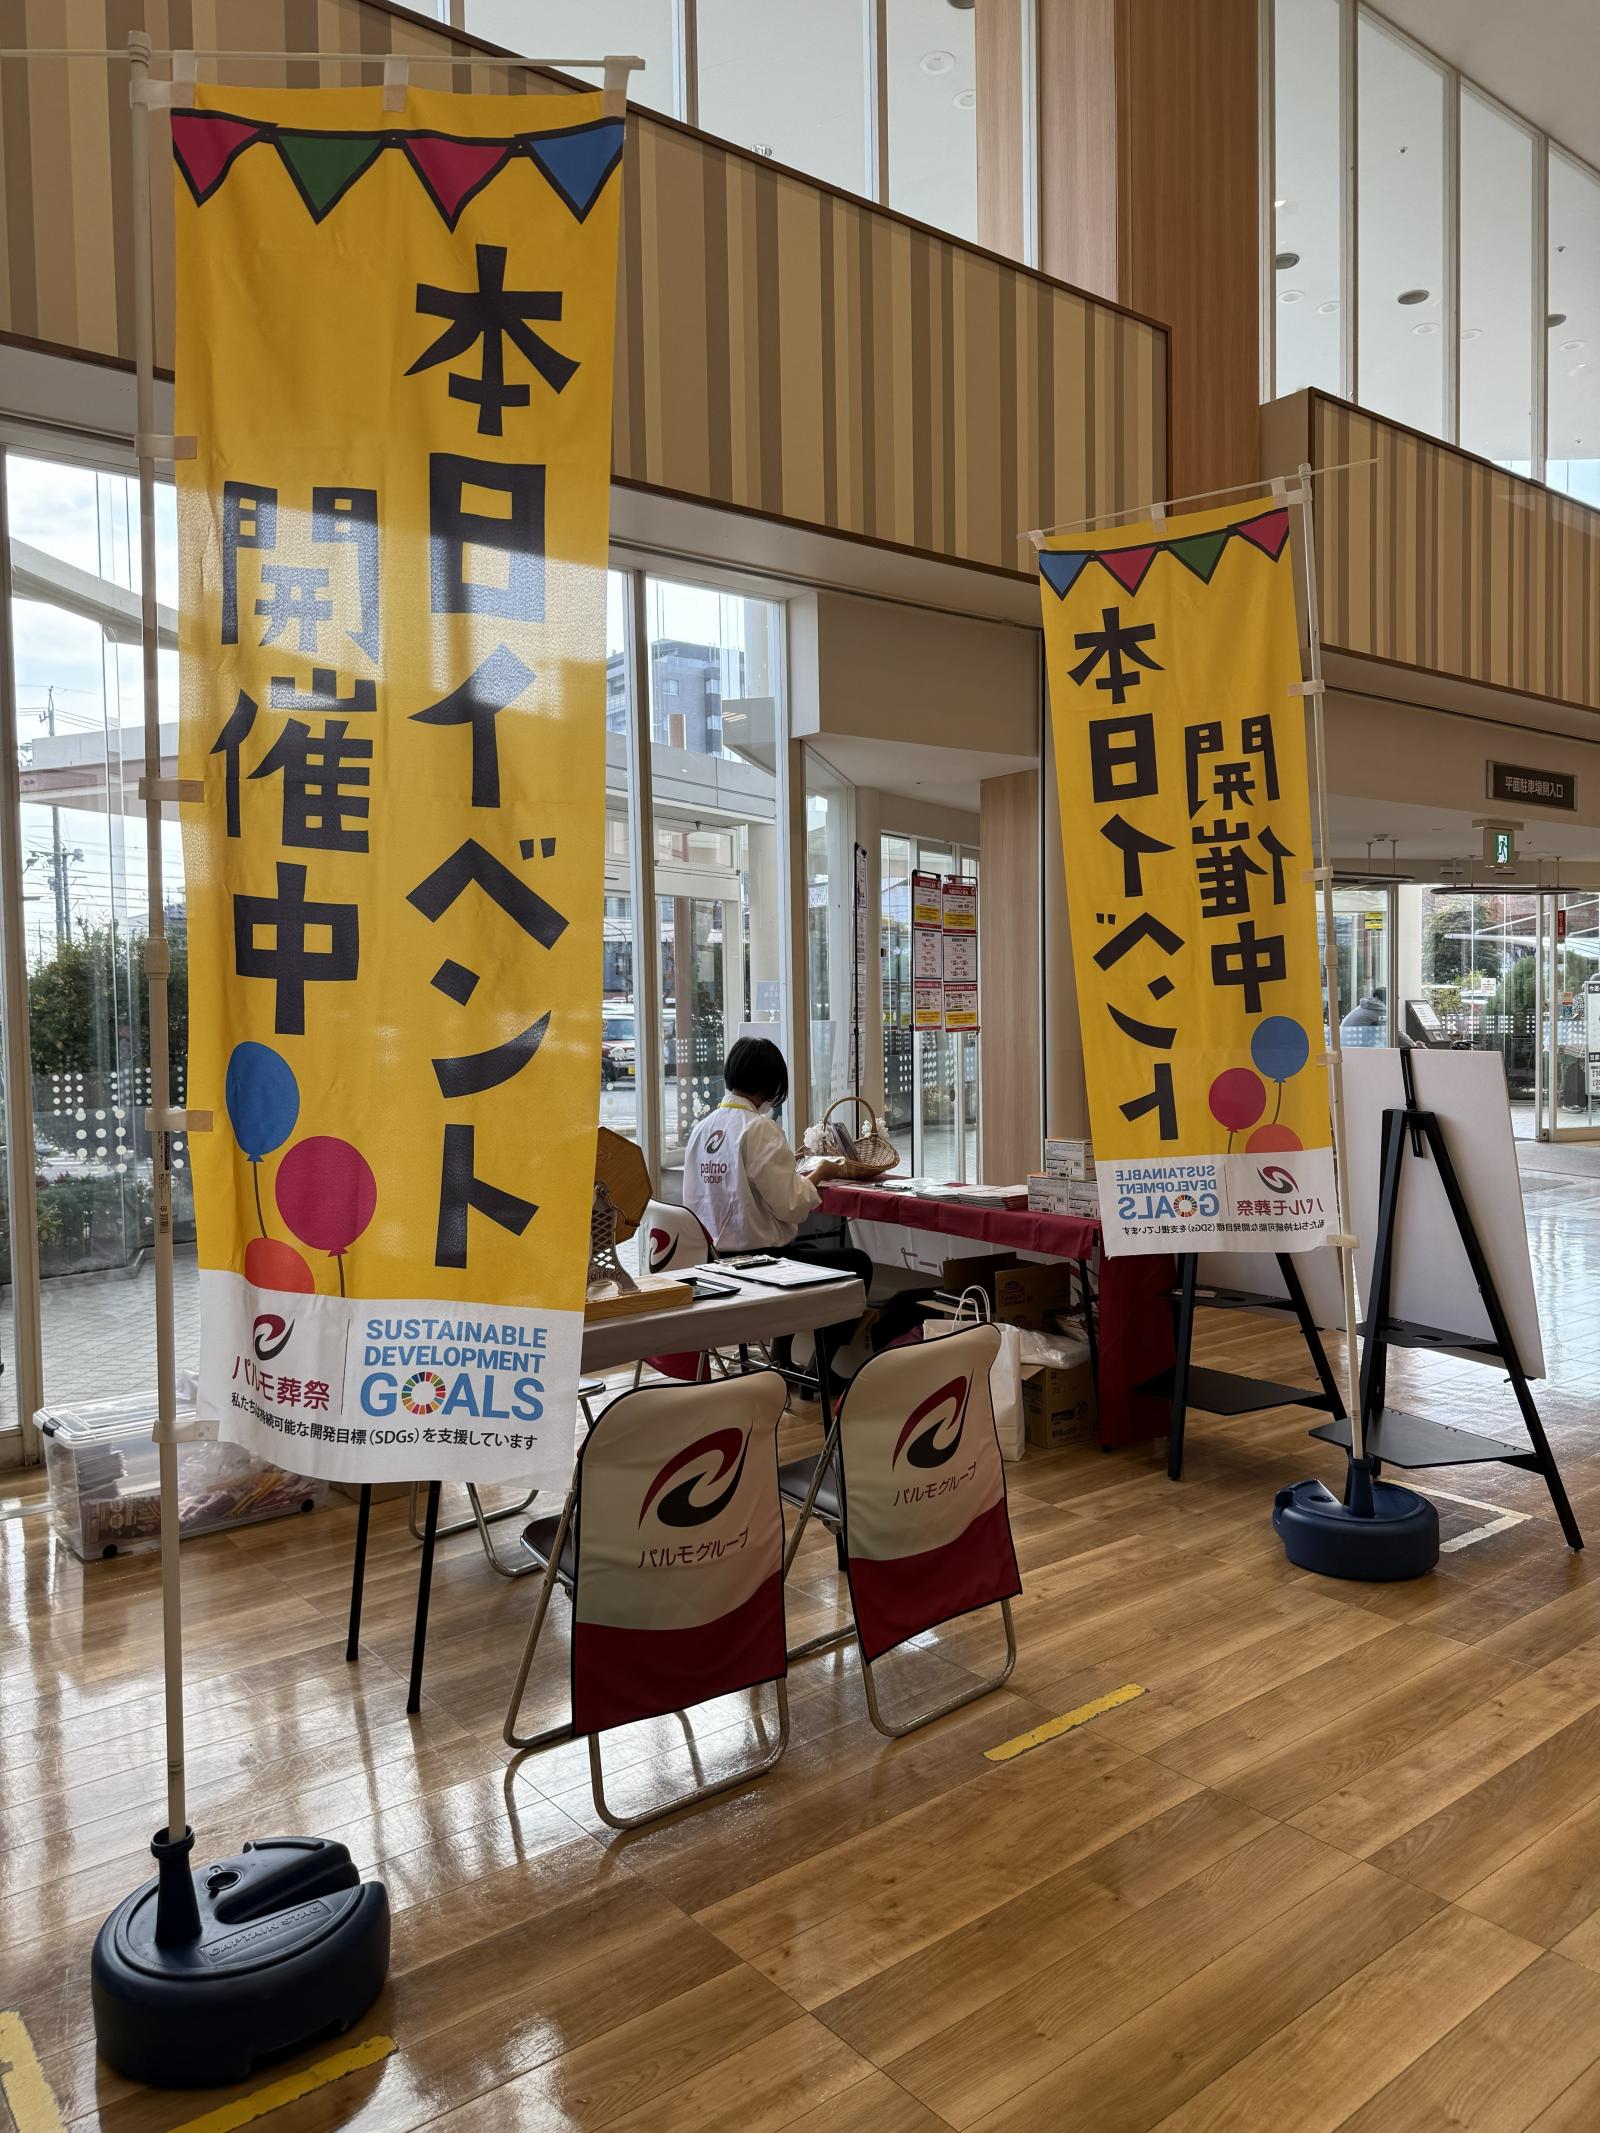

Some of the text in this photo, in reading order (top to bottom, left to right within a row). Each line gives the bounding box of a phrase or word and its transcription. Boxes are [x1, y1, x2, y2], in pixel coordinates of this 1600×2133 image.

[209, 480, 381, 1036] 開催中
[403, 243, 581, 1269] 本日イベント
[700, 1160, 728, 1177] palmo
[366, 1319, 548, 1349] SUSTAINABLE
[364, 1345, 546, 1374] DEVELOPMENT
[231, 1355, 331, 1412] パルモ葬祭
[360, 1370, 545, 1421] GOALS
[893, 1461, 977, 1507] パルモグループ
[637, 1526, 750, 1570] パルモグループ
[209, 1924, 280, 1956] CAPTAIN
